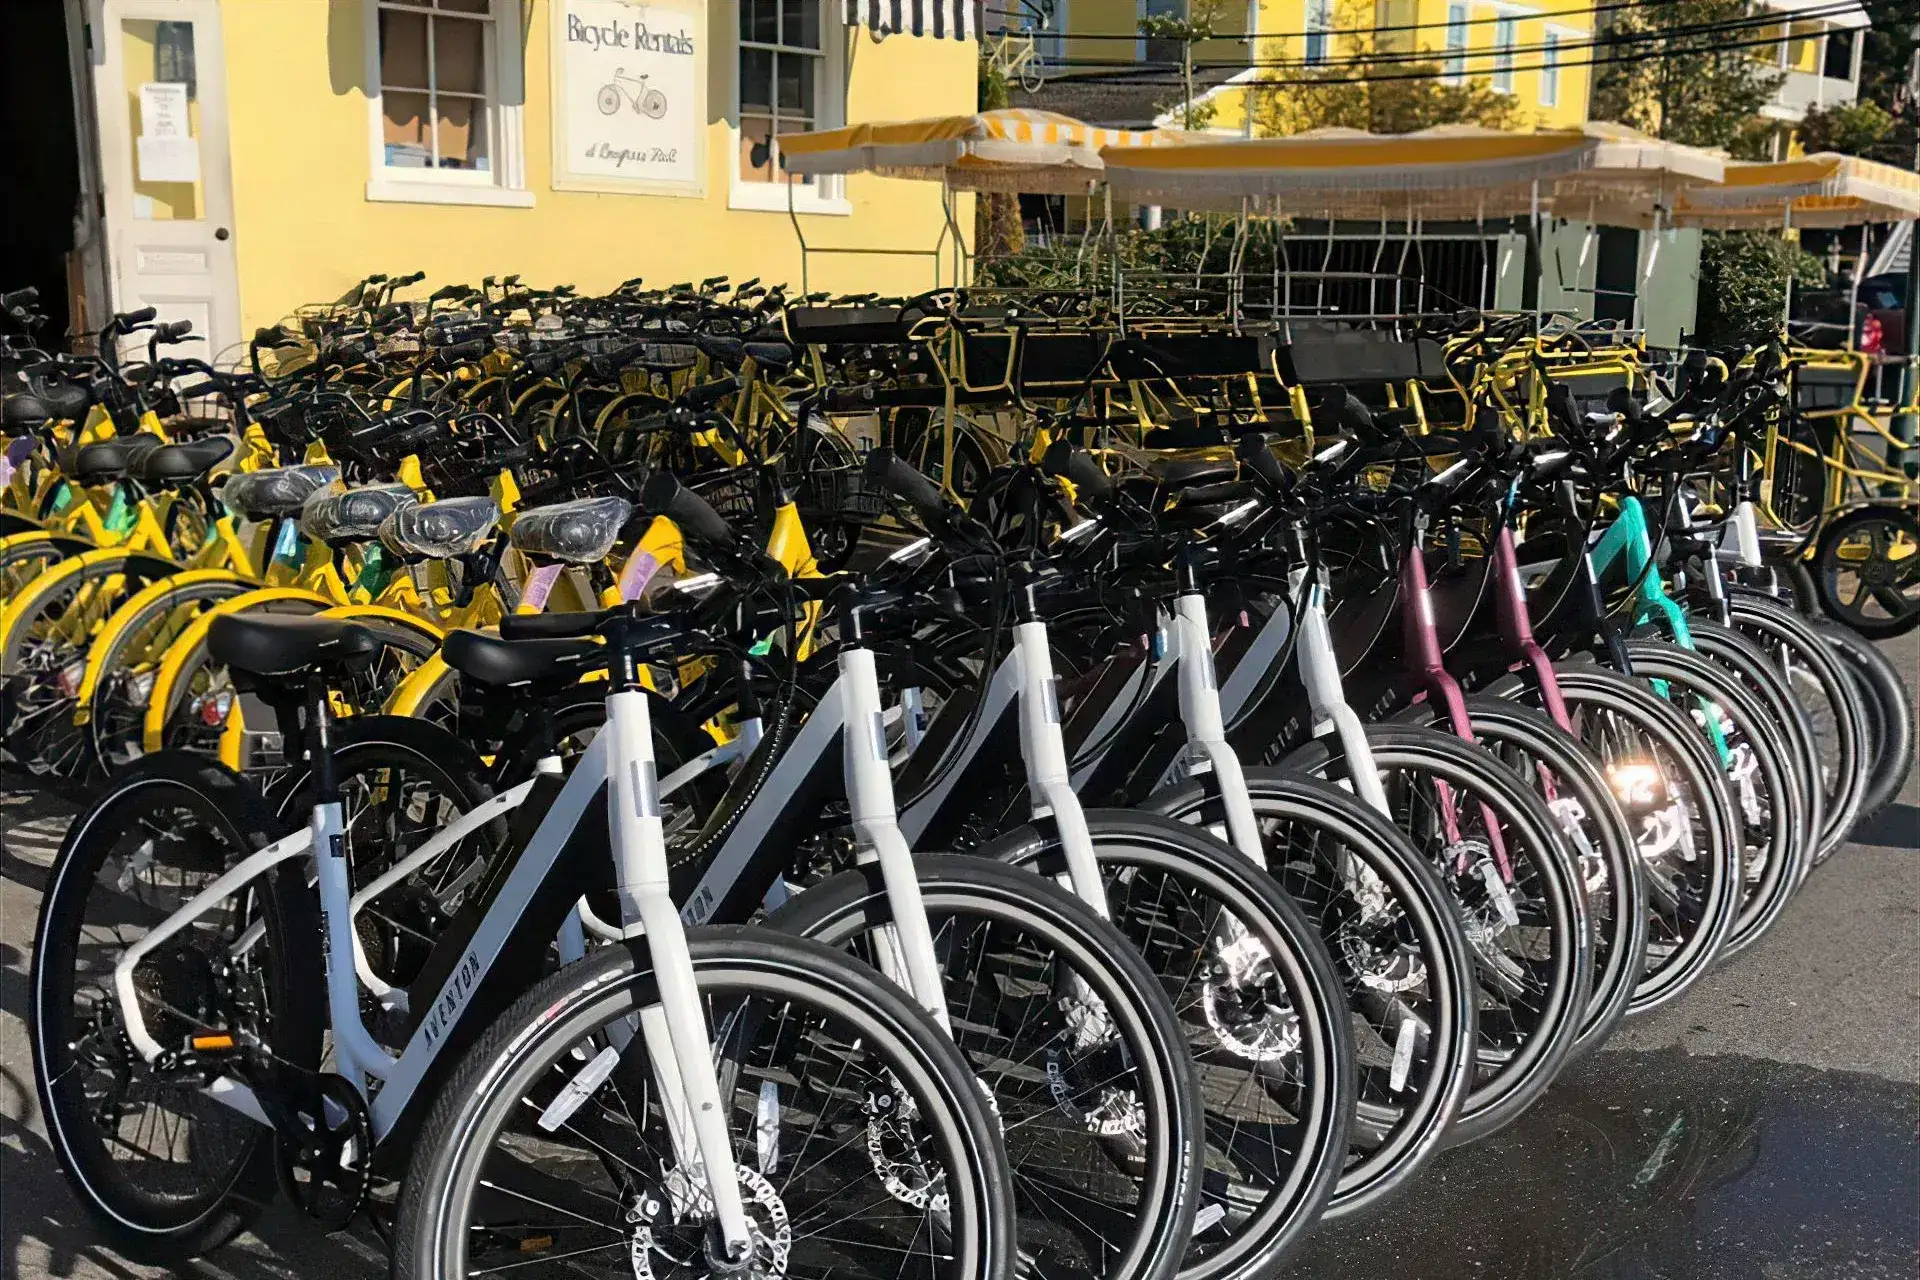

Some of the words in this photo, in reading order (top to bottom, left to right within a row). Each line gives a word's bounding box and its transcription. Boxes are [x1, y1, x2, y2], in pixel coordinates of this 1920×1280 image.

[567, 13, 630, 51] Bicycle
[634, 22, 694, 55] Rentals
[424, 950, 480, 1052] AVENTON
